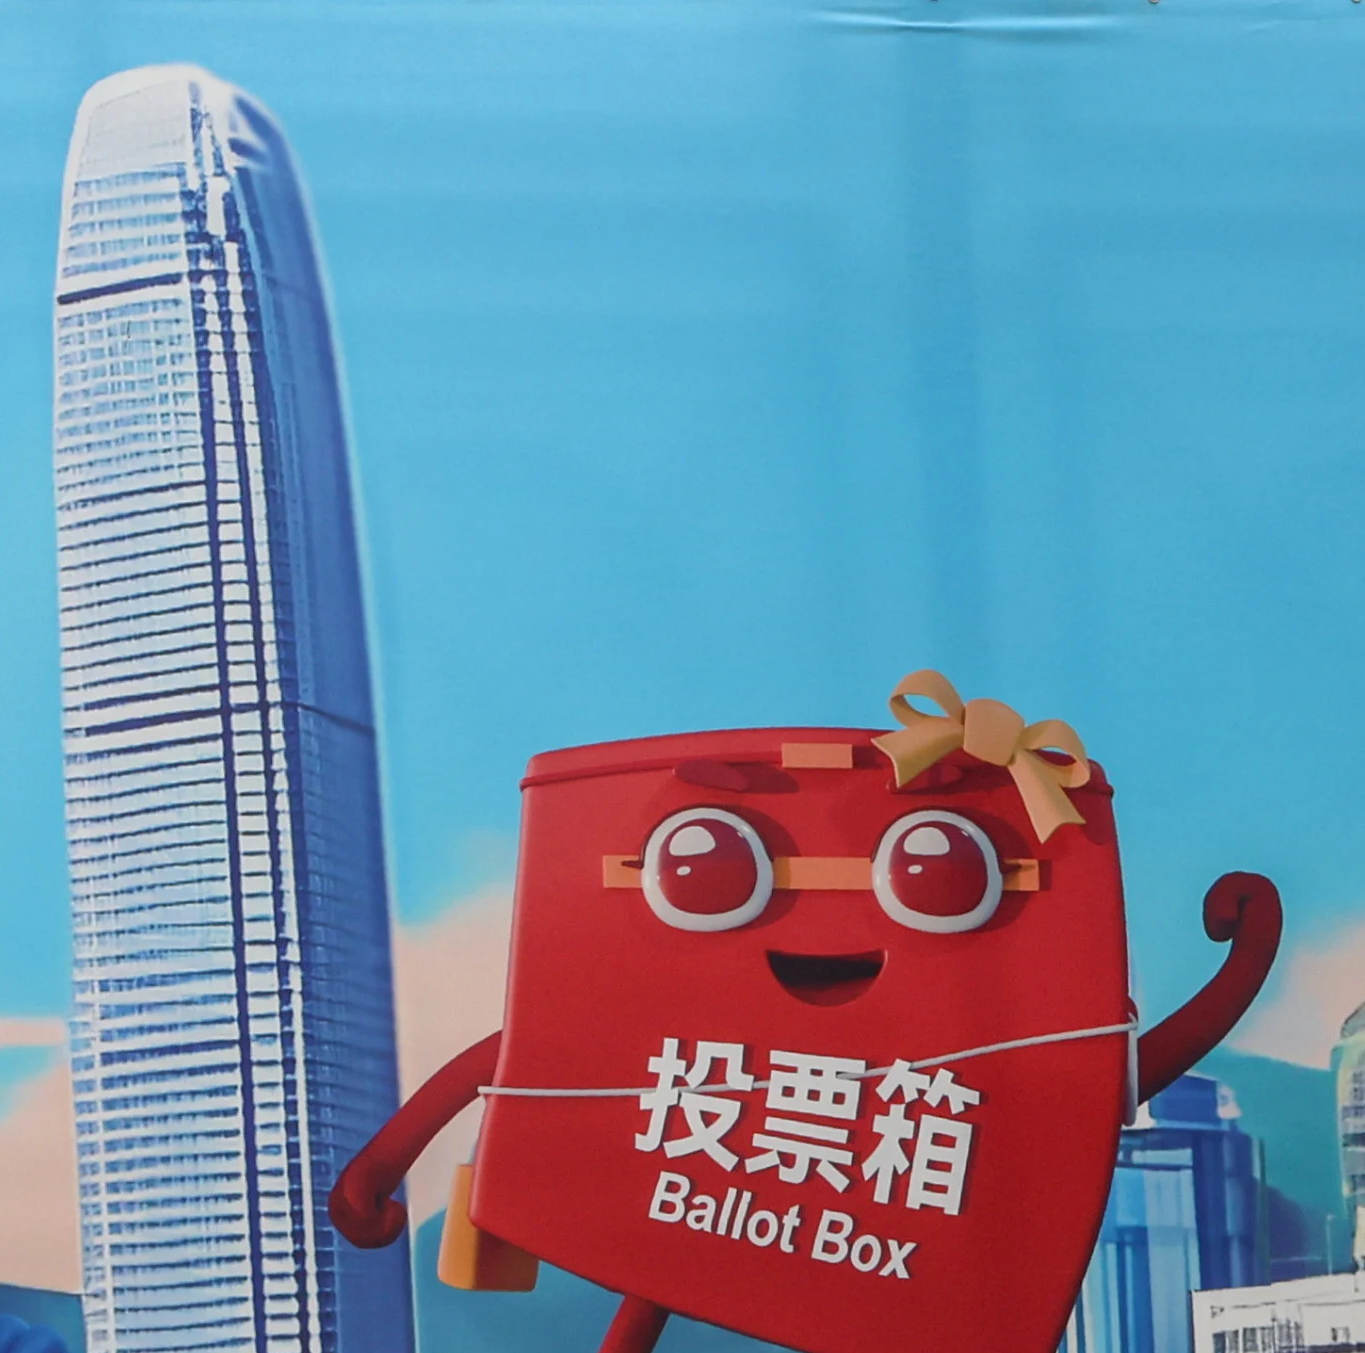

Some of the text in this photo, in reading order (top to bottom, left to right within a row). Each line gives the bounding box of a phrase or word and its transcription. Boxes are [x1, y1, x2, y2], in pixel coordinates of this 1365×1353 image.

[635, 1037, 980, 1216] 投票箱
[648, 1170, 917, 1279] Ballot Box
